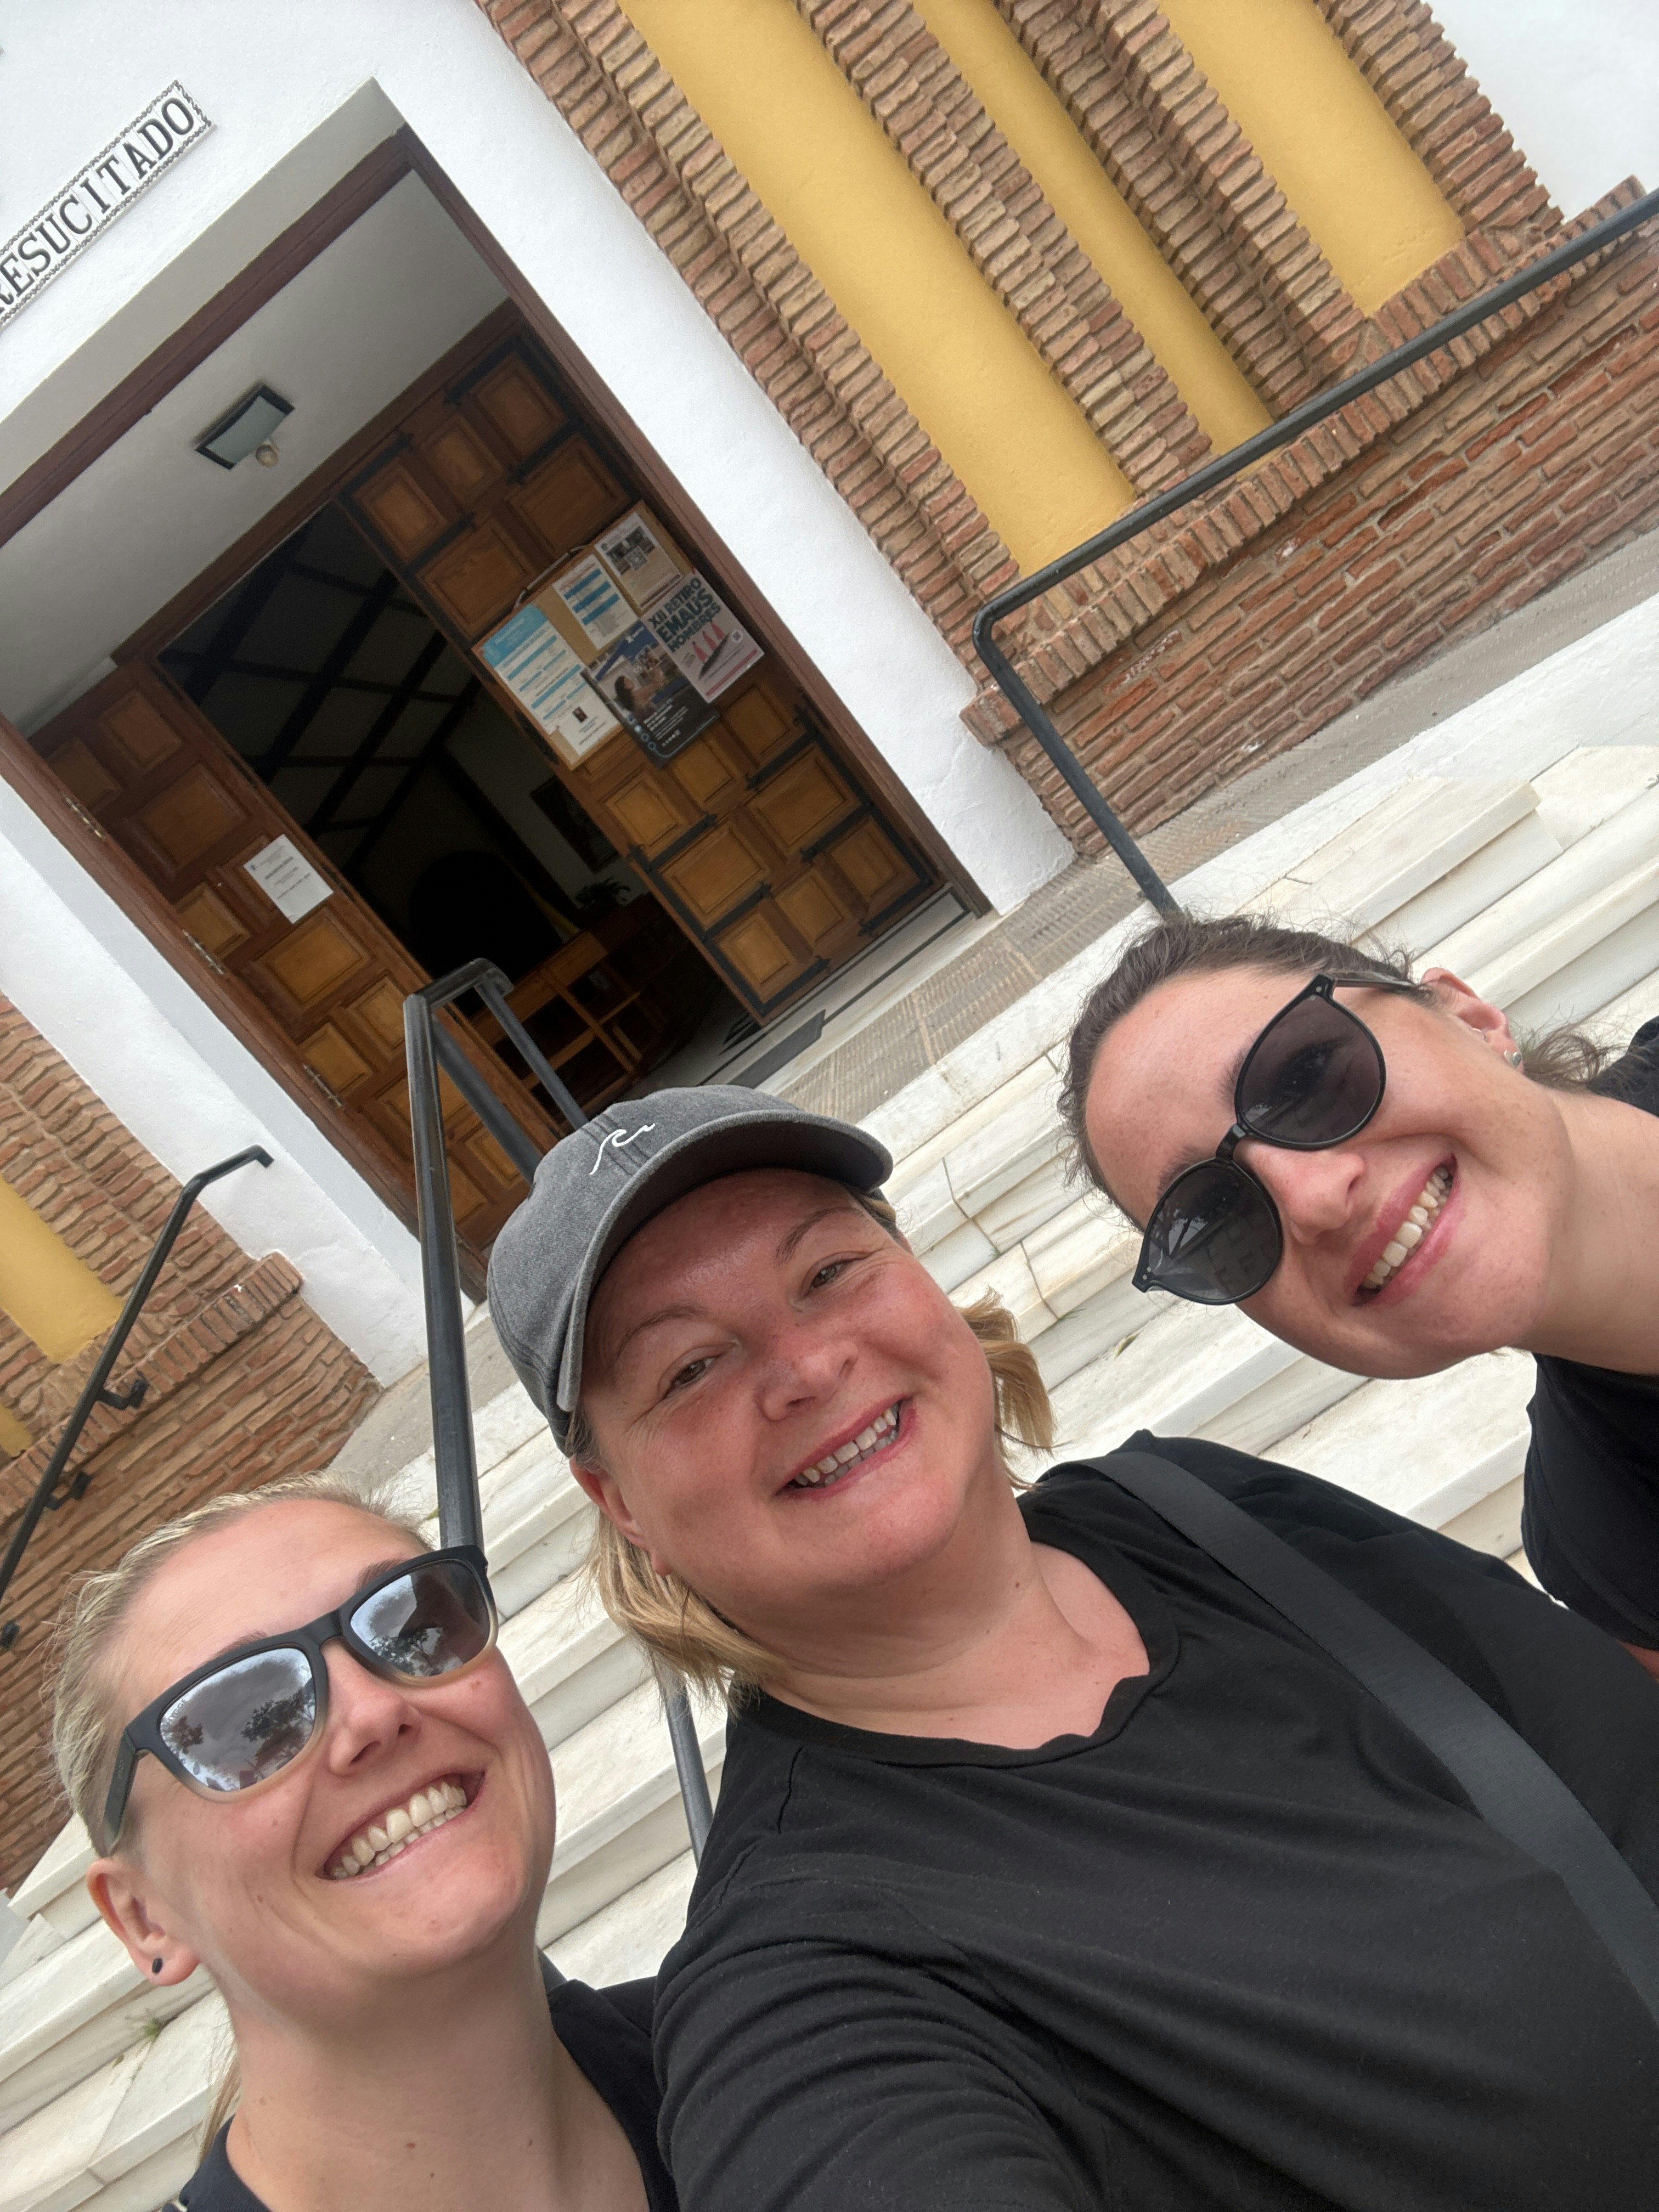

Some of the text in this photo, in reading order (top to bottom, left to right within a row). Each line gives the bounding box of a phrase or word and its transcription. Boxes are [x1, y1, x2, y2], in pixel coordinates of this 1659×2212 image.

[647, 577, 701, 630] XII RETIRO
[667, 601, 721, 653] HOMBRES
